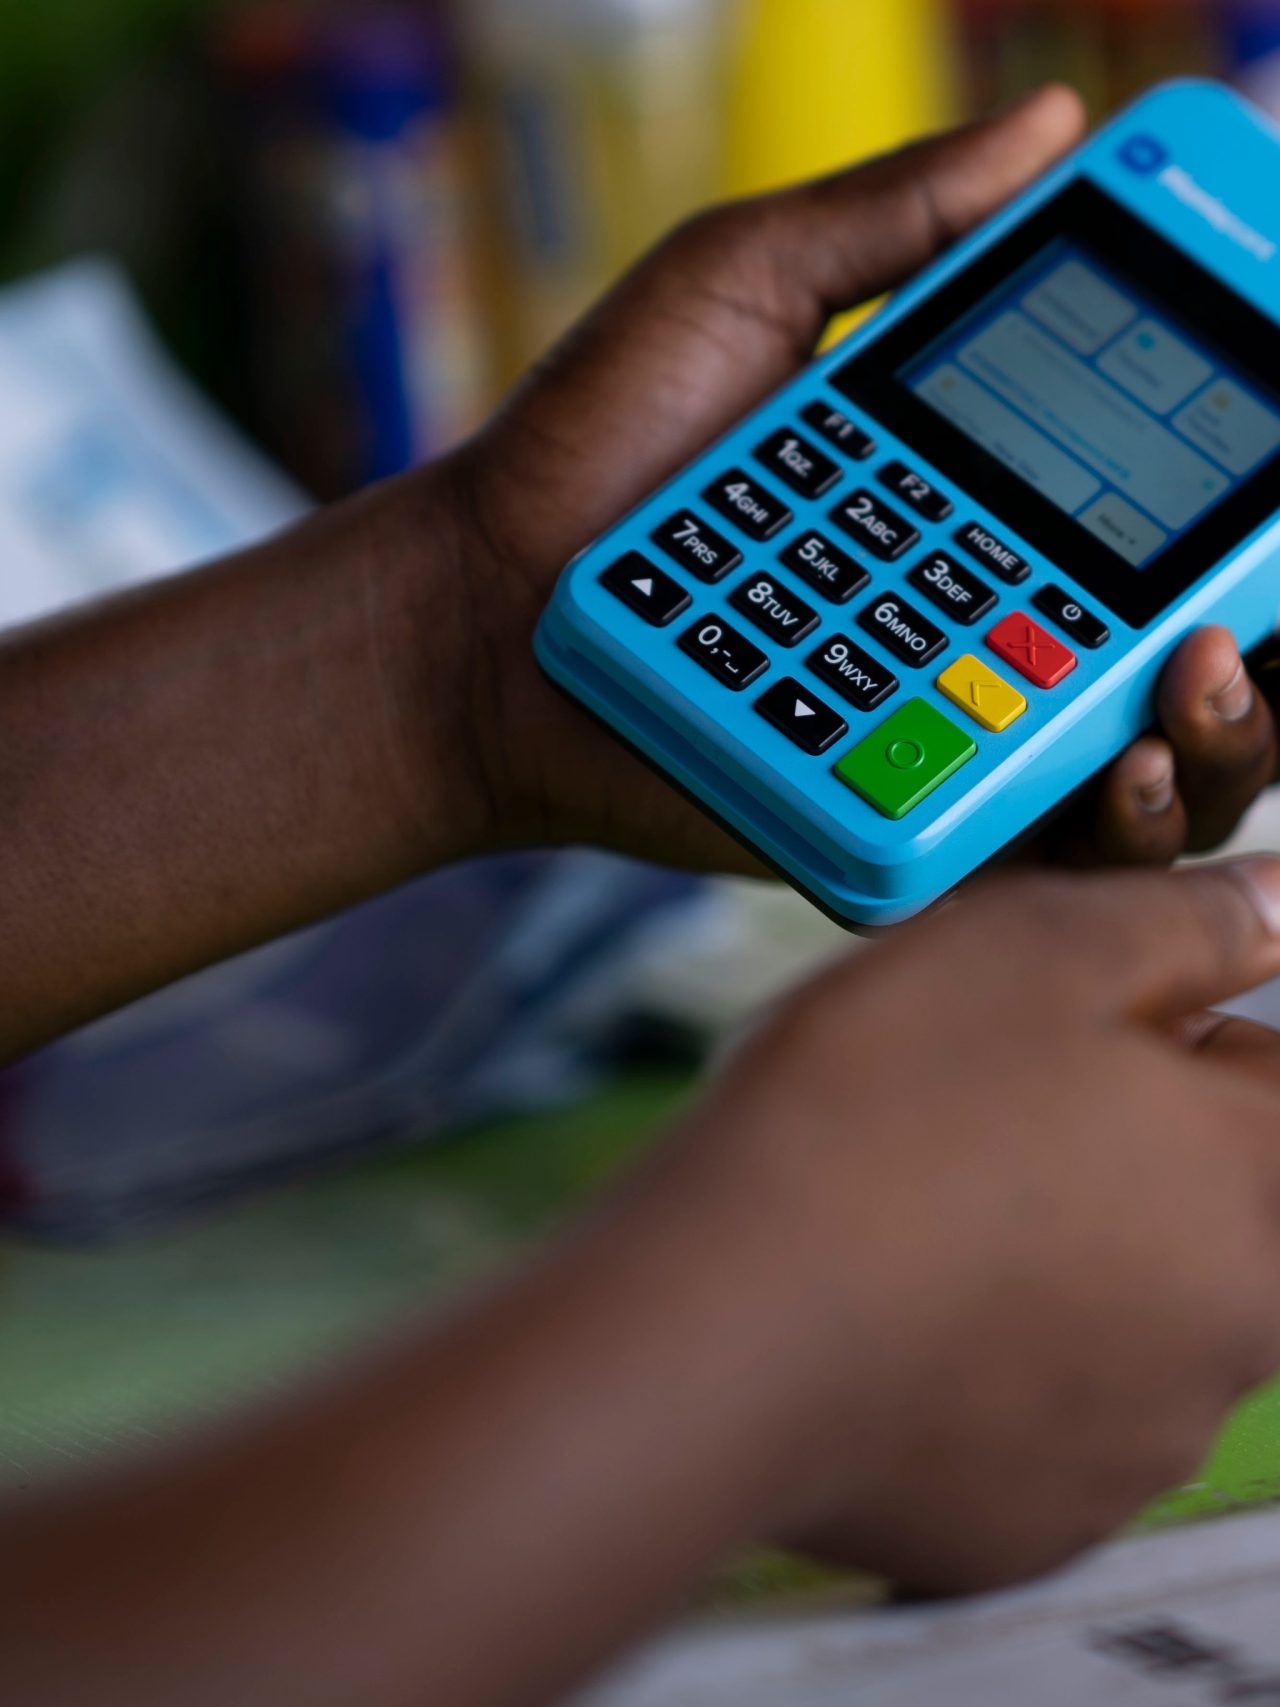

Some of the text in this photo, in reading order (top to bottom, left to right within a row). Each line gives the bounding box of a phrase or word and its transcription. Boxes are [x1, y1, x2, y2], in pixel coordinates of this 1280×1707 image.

[824, 412, 853, 438] F1
[724, 482, 768, 523] 4GHI
[900, 473, 931, 499] F2
[672, 519, 718, 565] 7PRS
[845, 497, 897, 544] 2ABC
[798, 538, 839, 582] 5JKL
[966, 528, 1019, 571] HOME
[923, 559, 973, 603] 3DEF
[747, 581, 799, 626] 8TUV
[874, 602, 927, 651] 6MNO
[824, 643, 878, 691] 9WXY
